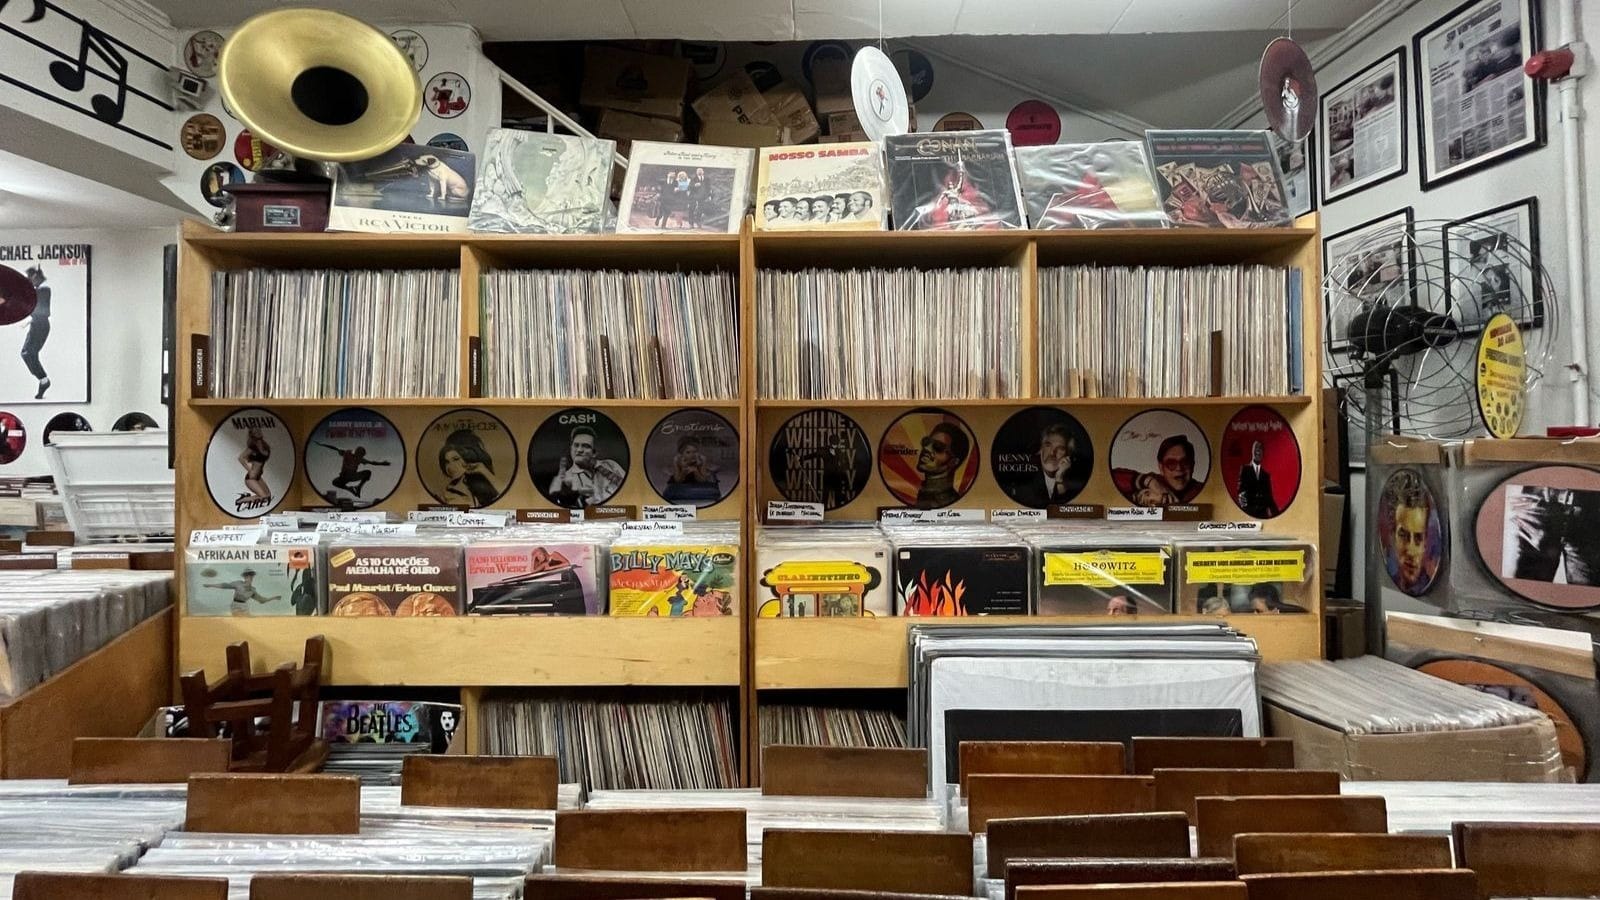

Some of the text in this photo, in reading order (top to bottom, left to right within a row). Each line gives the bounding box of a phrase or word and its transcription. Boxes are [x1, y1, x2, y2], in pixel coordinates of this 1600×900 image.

[769, 148, 870, 162] NOSSO SAMBA
[392, 218, 450, 233] VICTOR
[37, 244, 88, 260] JACKSON
[231, 416, 276, 430] MARIAH
[558, 413, 597, 425] CASH
[661, 420, 725, 435] Emotions
[785, 428, 857, 449] WHITNEY
[998, 453, 1032, 463] KENNY
[998, 463, 1039, 473] ROGERS
[235, 494, 274, 512] CAREY
[197, 549, 278, 560] AFRIKAAN BEAT
[355, 555, 430, 568] AS 10 CANÇÕES
[611, 550, 664, 574] BILLY
[1073, 561, 1137, 571] HOROWITZ
[345, 566, 440, 575] MEDALHA DE OURO
[469, 563, 527, 574] Erwin Wiener
[329, 583, 351, 592] Paul
[423, 583, 457, 592] Chaves
[346, 703, 413, 739] BEATLES
